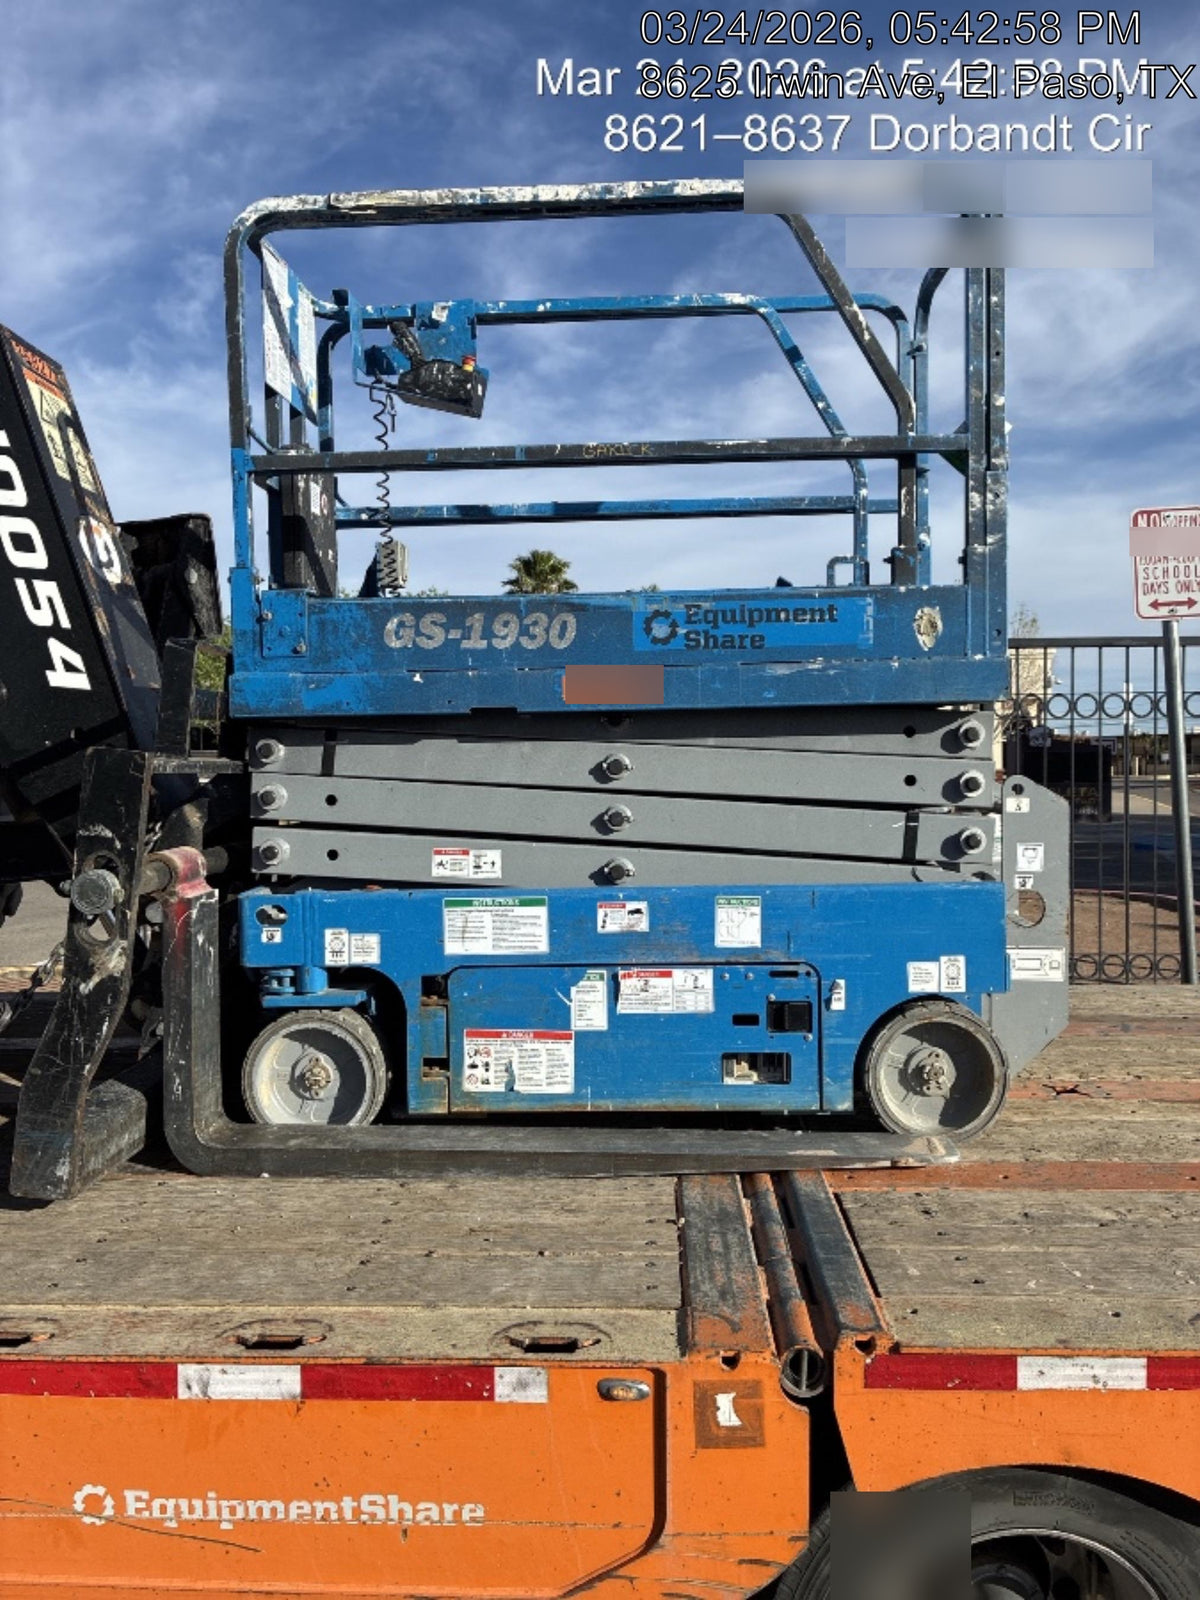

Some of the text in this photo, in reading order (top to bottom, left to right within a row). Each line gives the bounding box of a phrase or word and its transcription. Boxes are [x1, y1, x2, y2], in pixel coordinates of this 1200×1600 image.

[0, 429, 91, 690] 0054
[1142, 565, 1200, 580] SCHOOL
[1142, 581, 1169, 596] DAYS
[684, 604, 838, 628] Equipment
[384, 612, 577, 650] GS-1930
[684, 630, 766, 650] Share
[124, 1489, 485, 1529] EquipmentShare
